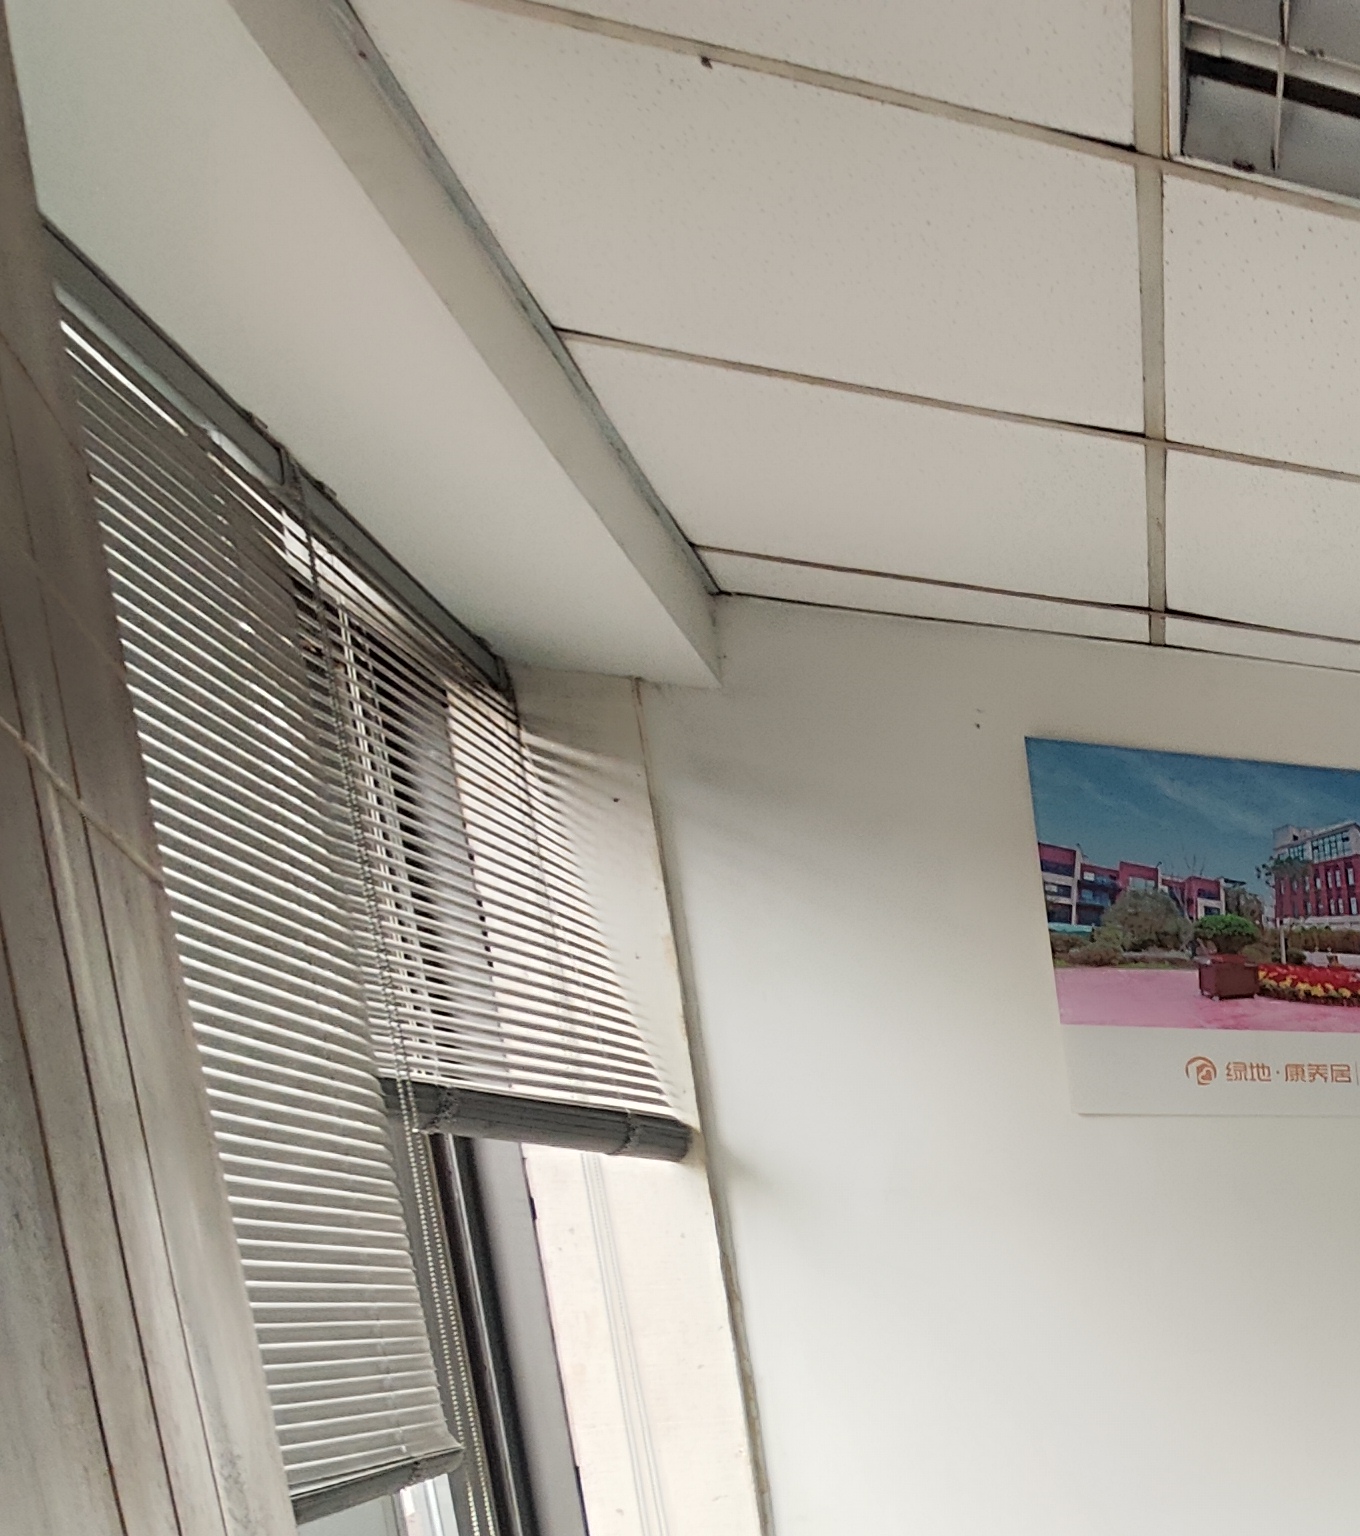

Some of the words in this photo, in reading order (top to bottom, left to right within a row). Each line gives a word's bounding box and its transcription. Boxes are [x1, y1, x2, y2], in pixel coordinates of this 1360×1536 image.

[1225, 1061, 1352, 1083] 绿地·康养居
